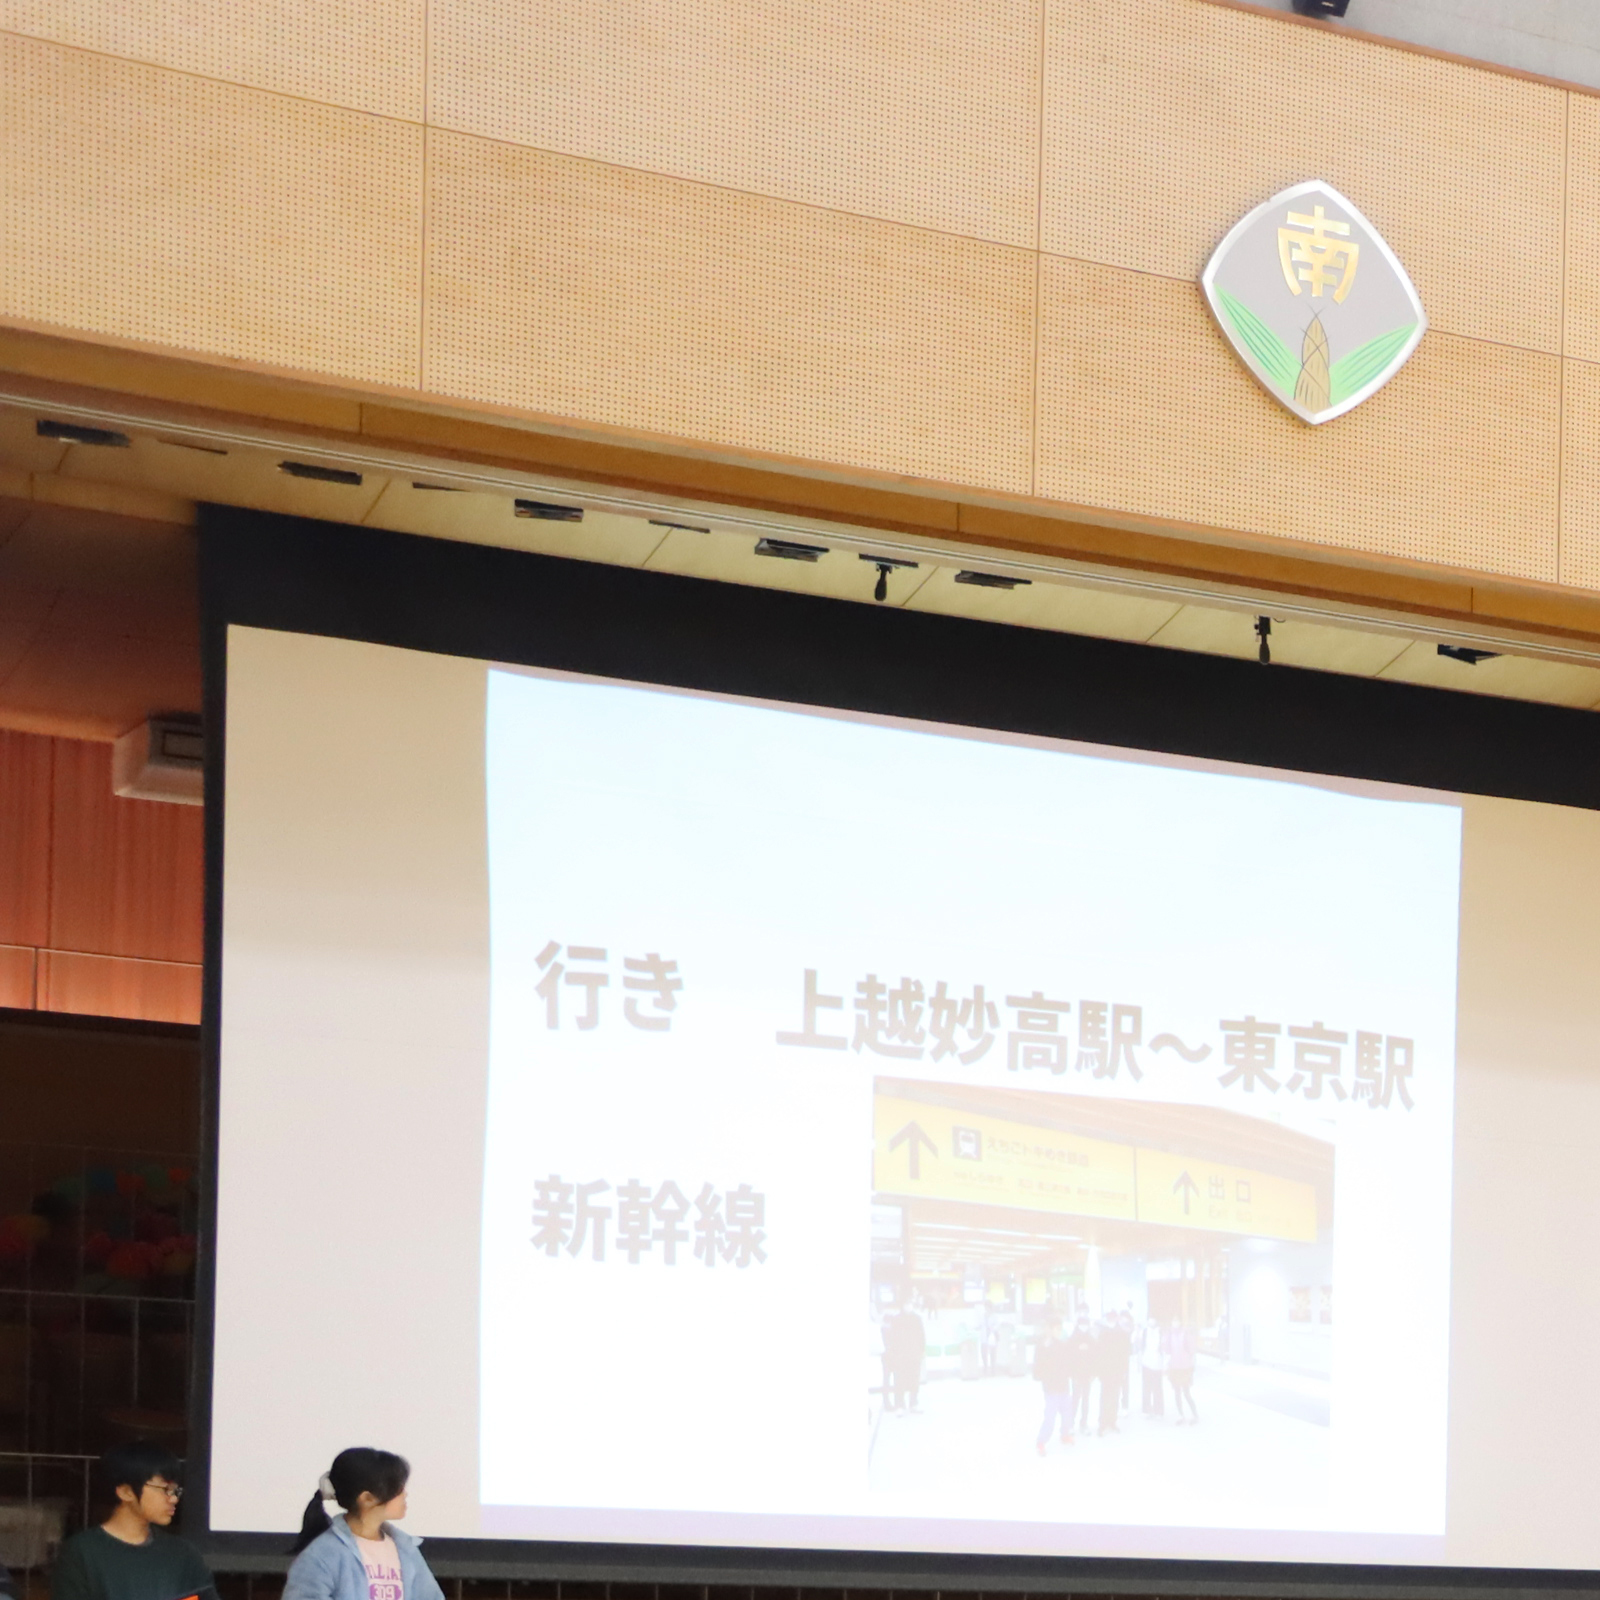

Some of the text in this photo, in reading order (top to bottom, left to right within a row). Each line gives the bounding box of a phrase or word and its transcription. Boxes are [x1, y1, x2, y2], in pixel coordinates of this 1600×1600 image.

[534, 940, 684, 1033] 行き
[1209, 1175, 1252, 1203] 出口
[530, 1174, 768, 1269] 新幹線
[374, 1584, 395, 1600] 309
